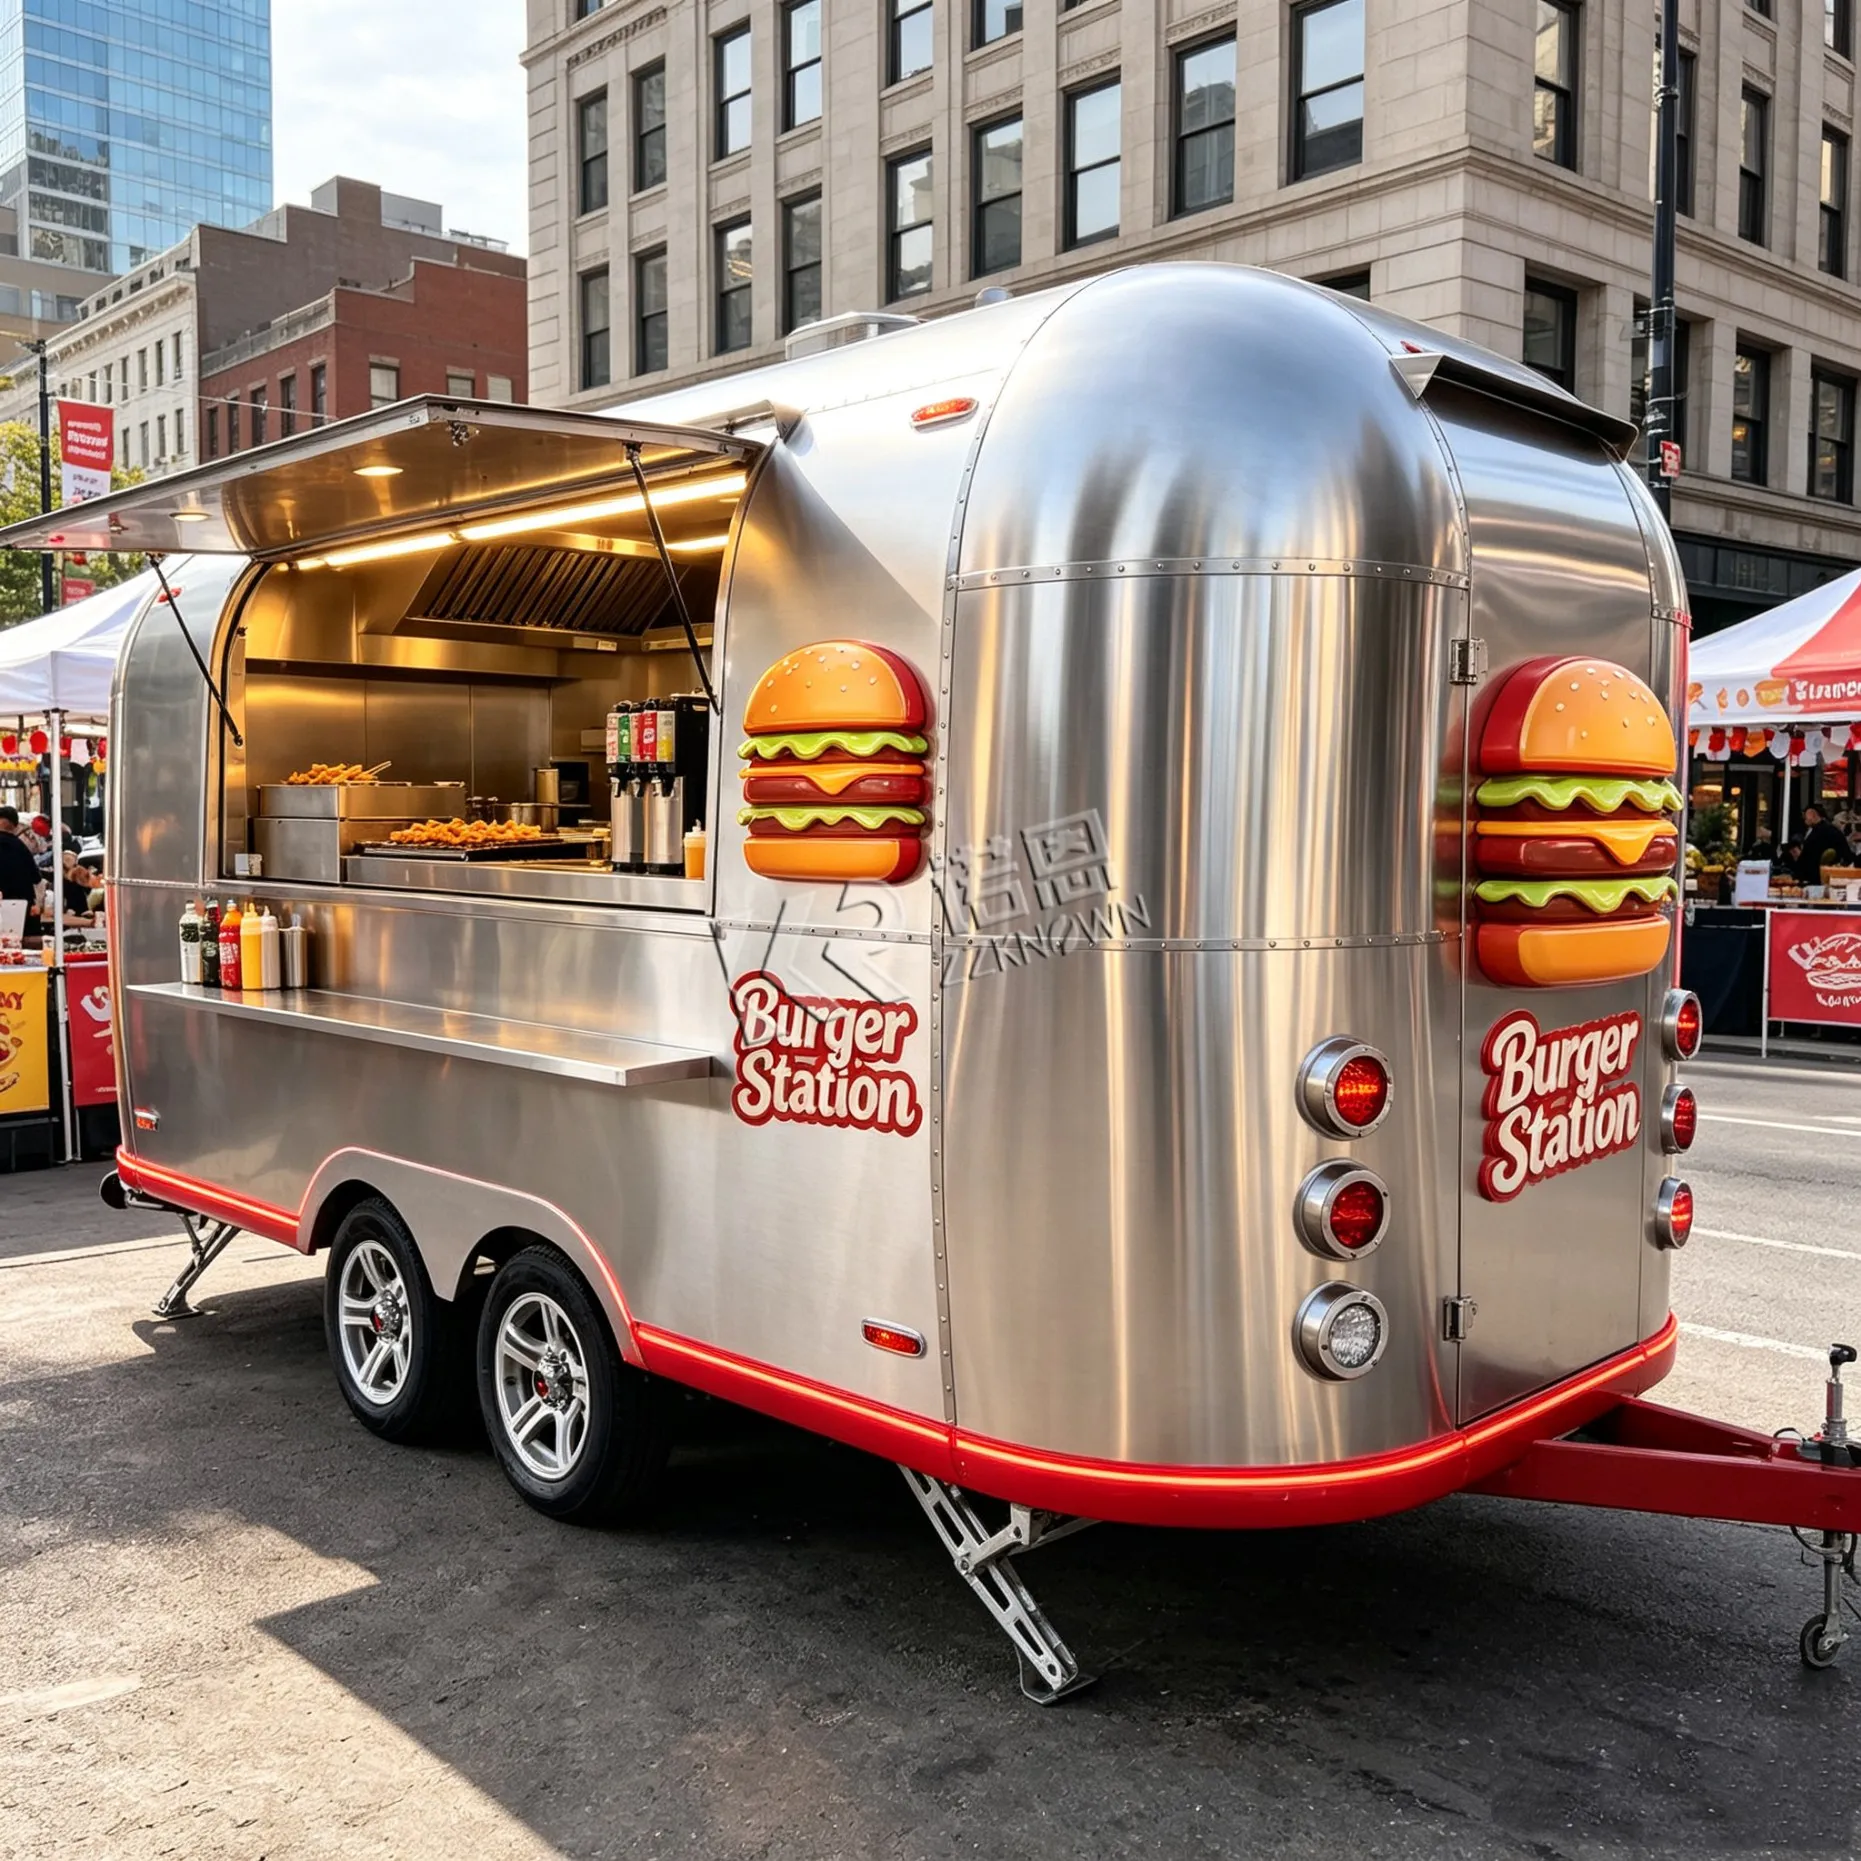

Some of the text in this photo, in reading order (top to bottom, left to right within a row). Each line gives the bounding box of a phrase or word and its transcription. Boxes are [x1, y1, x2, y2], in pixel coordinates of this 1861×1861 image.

[735, 977, 910, 1069] Burger
[1492, 1019, 1639, 1114] Burger
[737, 1048, 915, 1128] Station
[1491, 1092, 1641, 1193] Station
